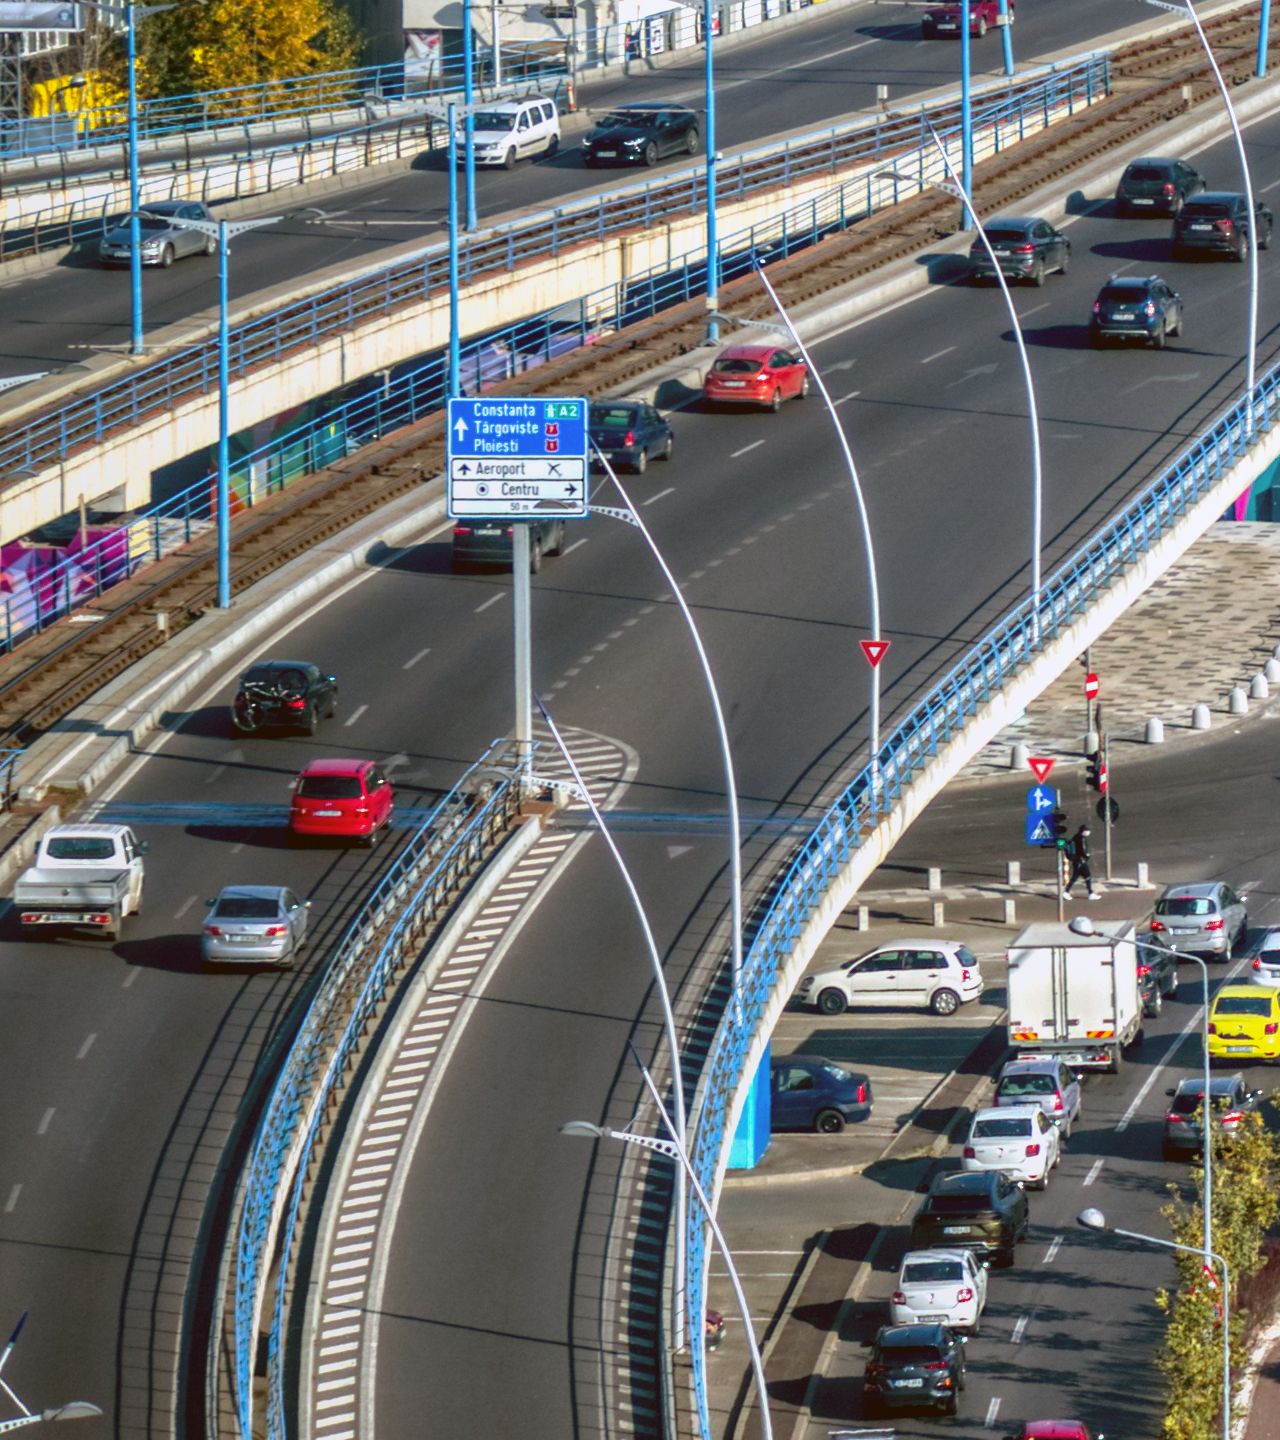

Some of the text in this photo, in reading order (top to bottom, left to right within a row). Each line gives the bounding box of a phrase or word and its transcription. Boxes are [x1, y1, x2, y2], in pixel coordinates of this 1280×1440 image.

[476, 462, 526, 478] Aeroport
[501, 482, 540, 496] Centru
[510, 502, 520, 511] 50
